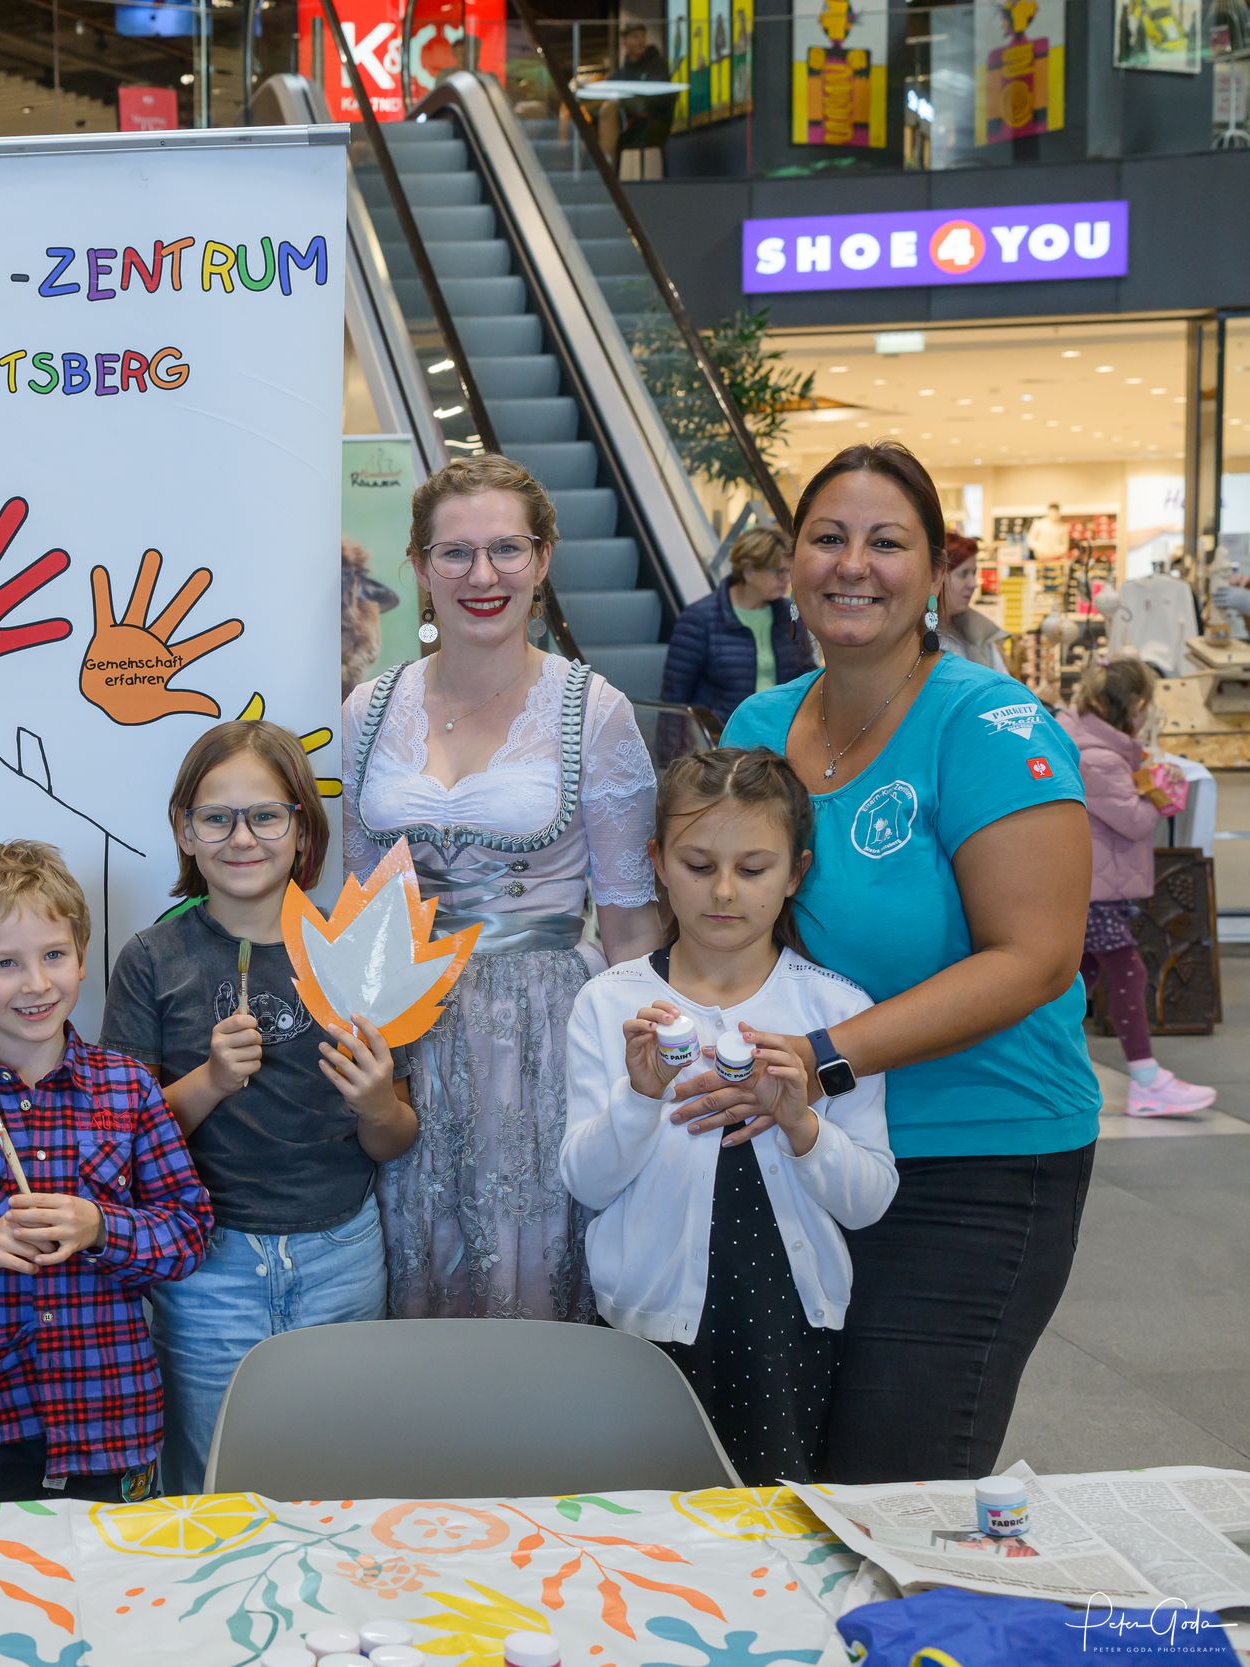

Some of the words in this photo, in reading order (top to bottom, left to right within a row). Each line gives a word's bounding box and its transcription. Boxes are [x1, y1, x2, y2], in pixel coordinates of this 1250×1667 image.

[755, 231, 918, 275] SHOE
[937, 228, 976, 266] 4
[991, 220, 1112, 263] YOU
[37, 235, 329, 302] ZENTRUM
[83, 655, 184, 672] Gemeinschaft
[104, 672, 166, 688] erfahren
[991, 705, 1034, 720] PARKETT
[670, 1051, 693, 1061] PAINT
[991, 1517, 1024, 1527] FABRIC
